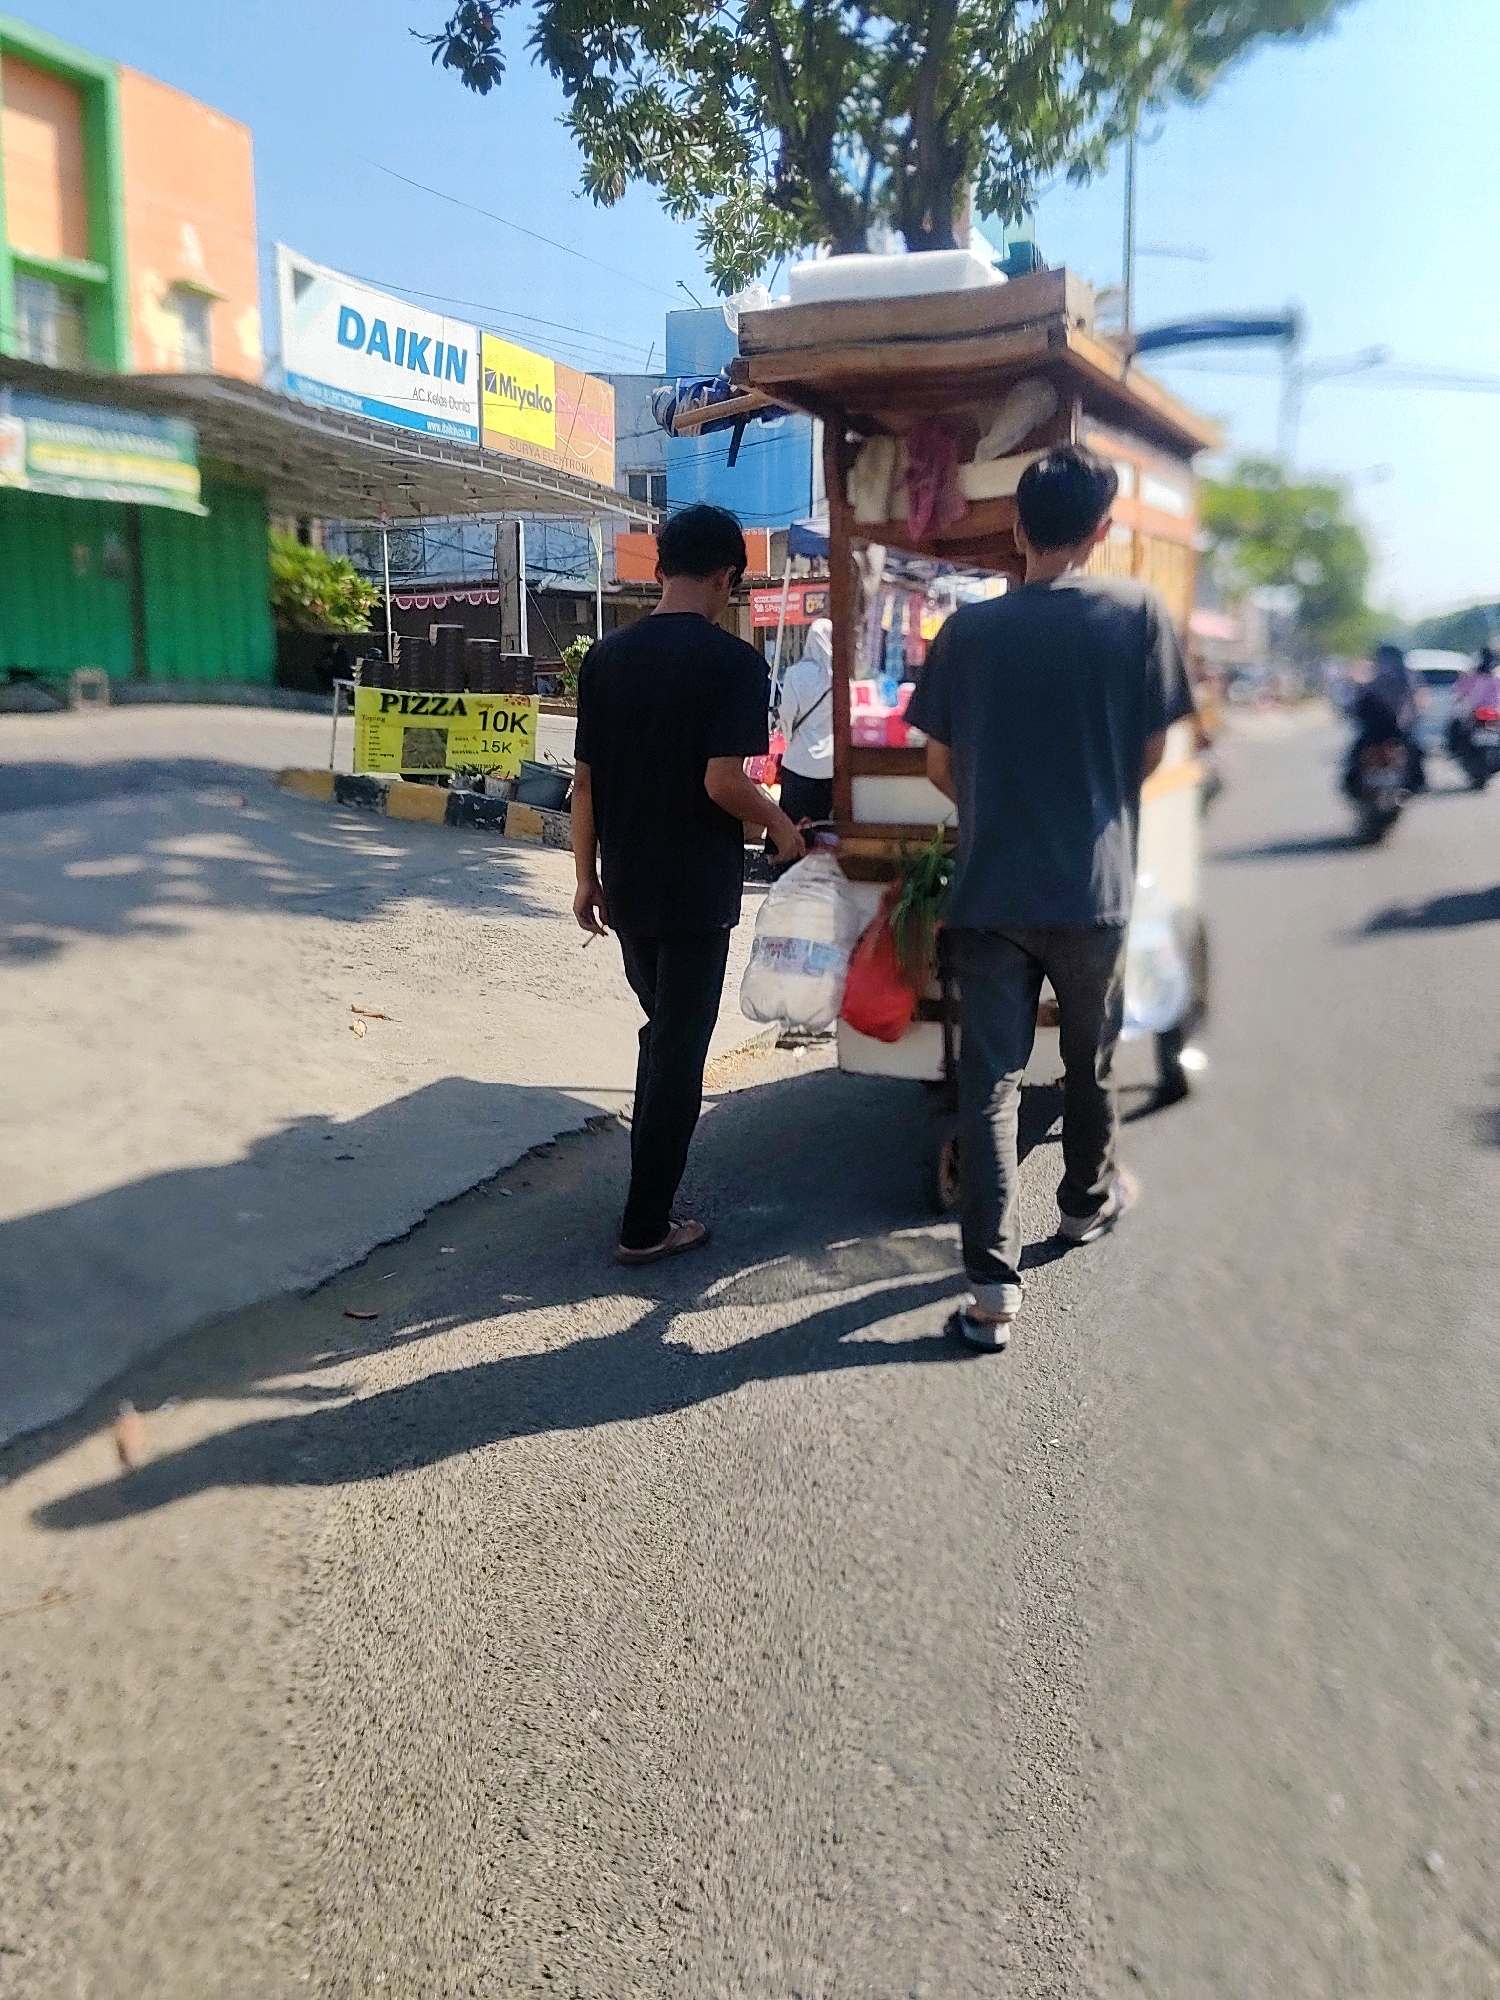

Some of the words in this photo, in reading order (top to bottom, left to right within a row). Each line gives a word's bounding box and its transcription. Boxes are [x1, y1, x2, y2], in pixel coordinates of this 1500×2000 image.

[337, 304, 468, 385] DAIKIN
[412, 387, 426, 402] AC
[427, 390, 448, 408] Kelas
[498, 373, 553, 414] Miyako
[509, 439, 541, 459] SURYA
[542, 452, 595, 476] ELEKTRONIK
[379, 692, 468, 717] PIZZA
[478, 710, 529, 735] 10K
[480, 739, 512, 754] 15K
